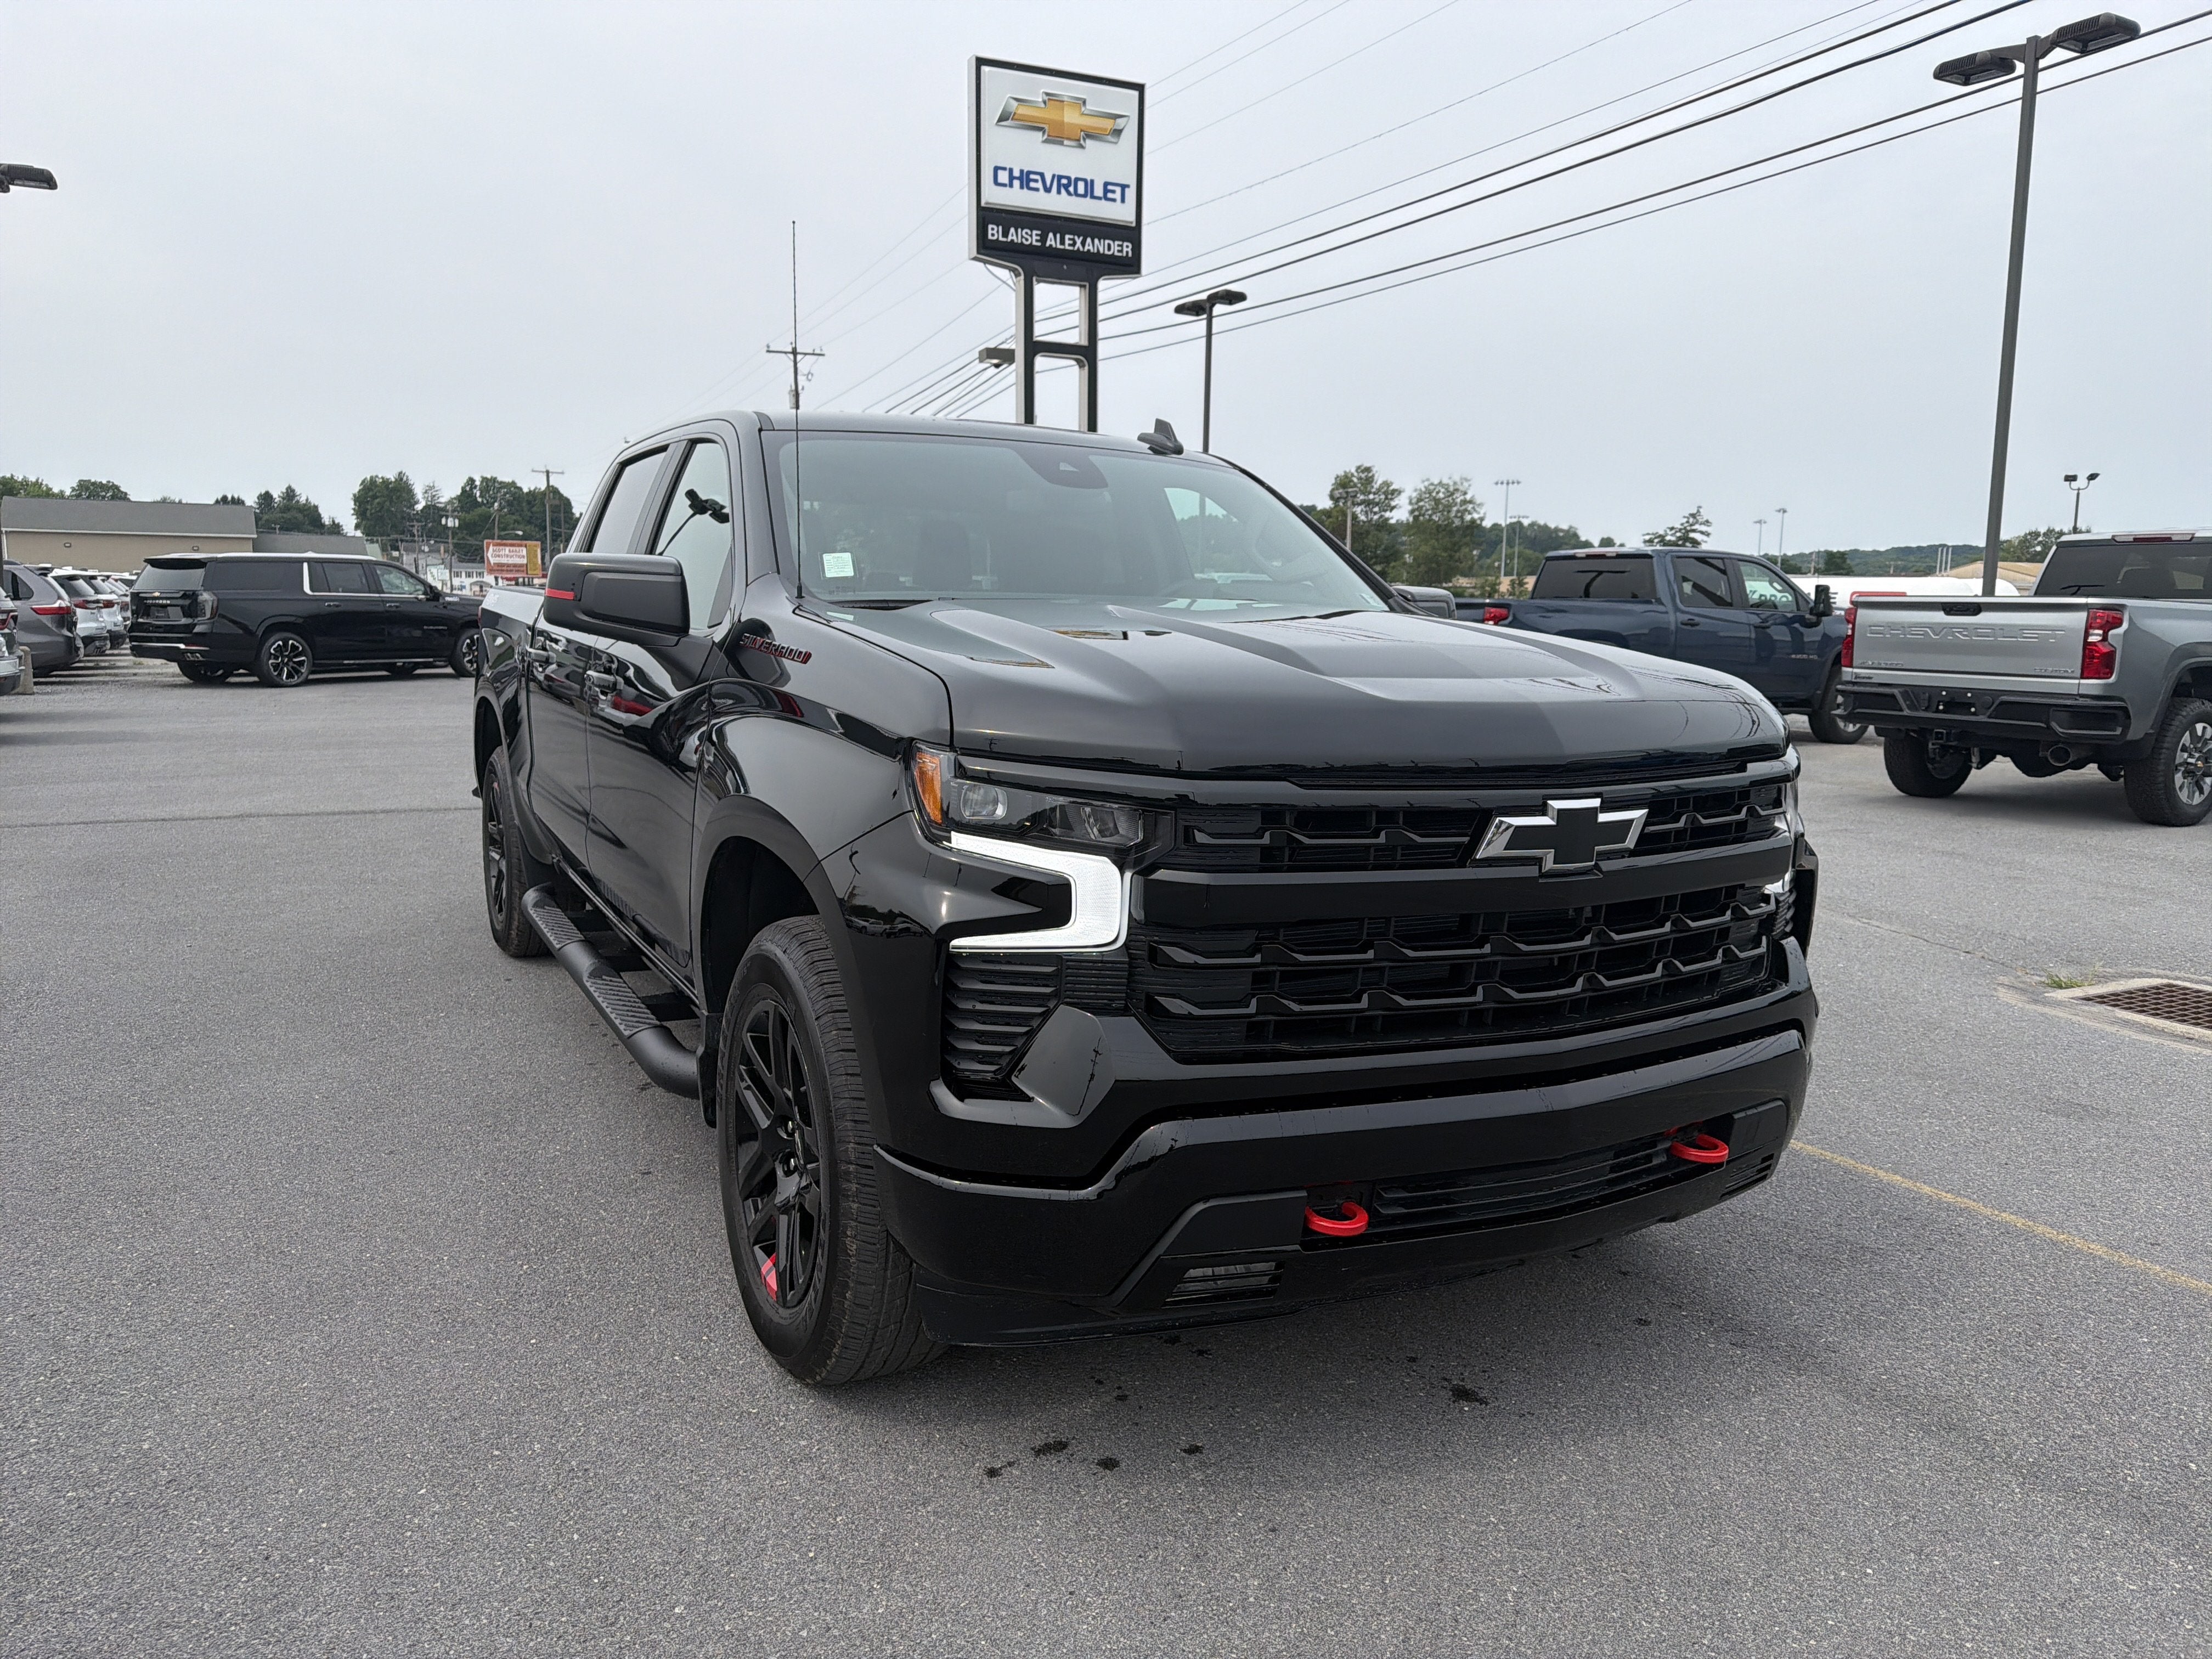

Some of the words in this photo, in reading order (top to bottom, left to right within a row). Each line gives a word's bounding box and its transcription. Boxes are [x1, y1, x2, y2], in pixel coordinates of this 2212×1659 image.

[993, 165, 1130, 204] CHEVROLET
[988, 224, 1042, 246] BLAISE
[1046, 232, 1133, 258] ALEXANDER
[739, 633, 812, 664] SILVERADO
[1866, 625, 2066, 642] CHEVROLET
